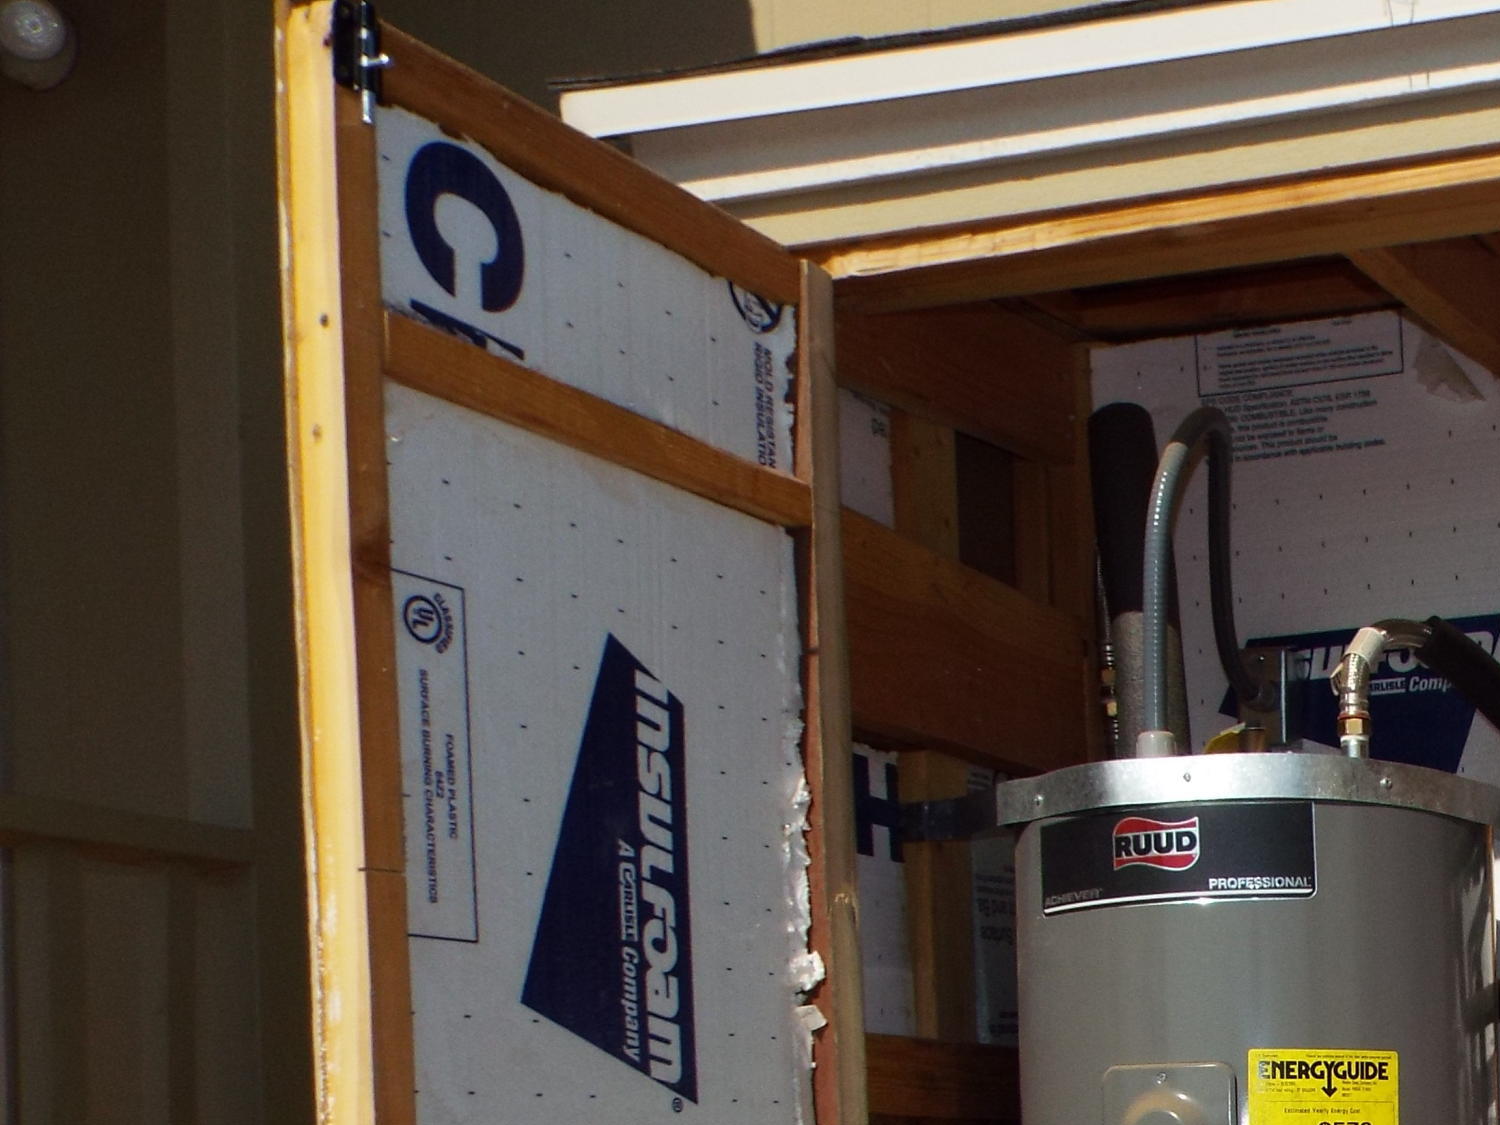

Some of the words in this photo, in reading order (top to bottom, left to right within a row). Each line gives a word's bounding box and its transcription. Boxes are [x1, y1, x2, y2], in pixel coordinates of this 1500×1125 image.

[405, 141, 525, 360] C
[756, 386, 767, 466] INSULATIO
[766, 394, 776, 468] RESISTAN
[1370, 677, 1406, 695] RLISLE
[1408, 675, 1451, 693] Comp
[445, 734, 457, 785] FOAMED
[448, 788, 458, 840] PLASTIC
[424, 789, 438, 903] CHARACTERISTICS
[619, 839, 635, 857] A
[1114, 831, 1198, 858] RUUD
[619, 862, 639, 942] CARLISLE
[1208, 876, 1311, 891] PROFESSIONAL
[622, 947, 641, 1063] Company
[1258, 1060, 1389, 1081] ENERGYGUIDE
